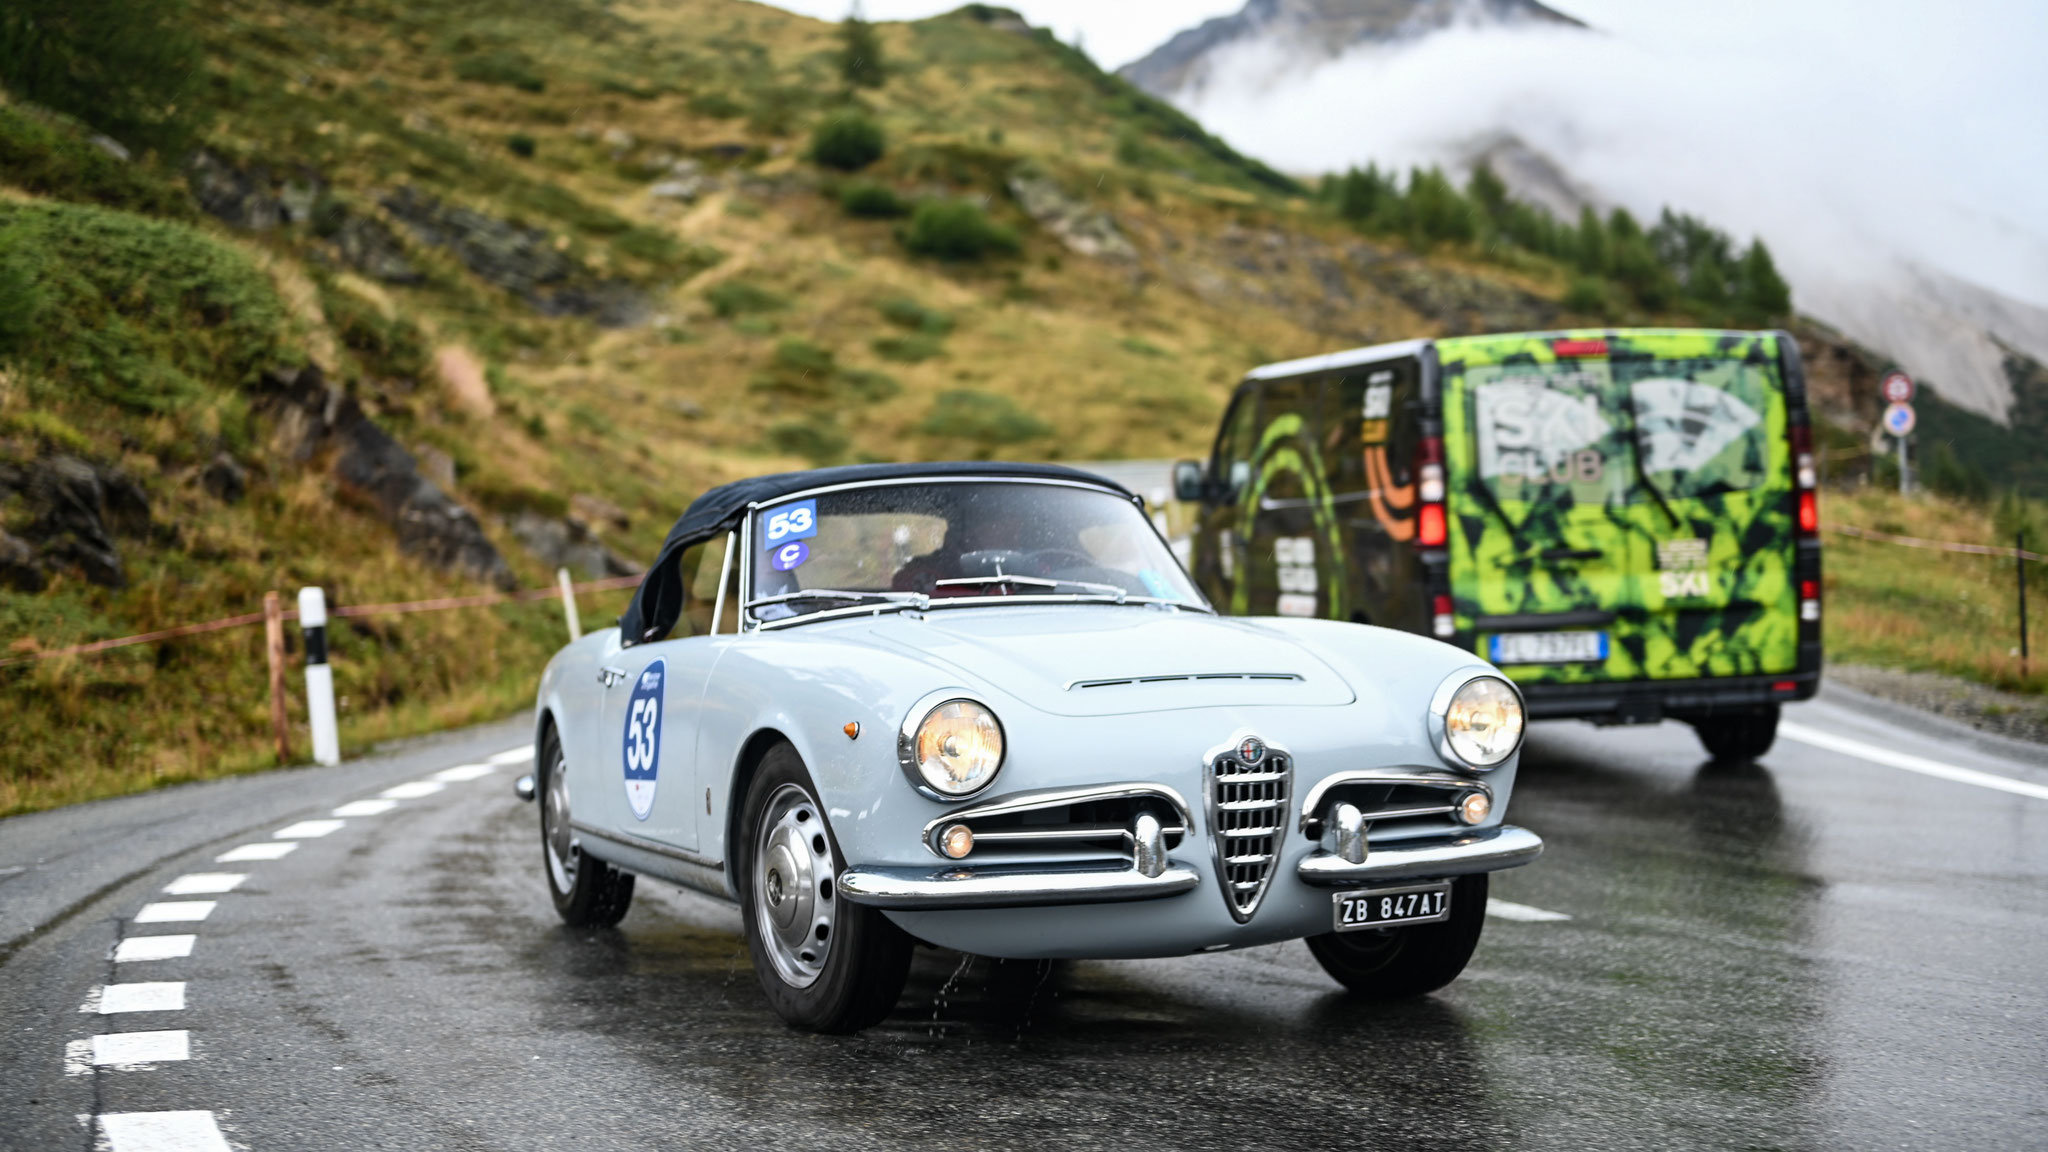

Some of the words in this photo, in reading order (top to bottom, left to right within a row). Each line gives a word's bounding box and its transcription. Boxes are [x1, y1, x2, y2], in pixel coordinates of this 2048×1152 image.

[767, 507, 813, 540] 53
[779, 544, 801, 562] C
[627, 696, 658, 771] 53
[1342, 899, 1368, 922] ZB
[1380, 892, 1444, 919] 847AT
